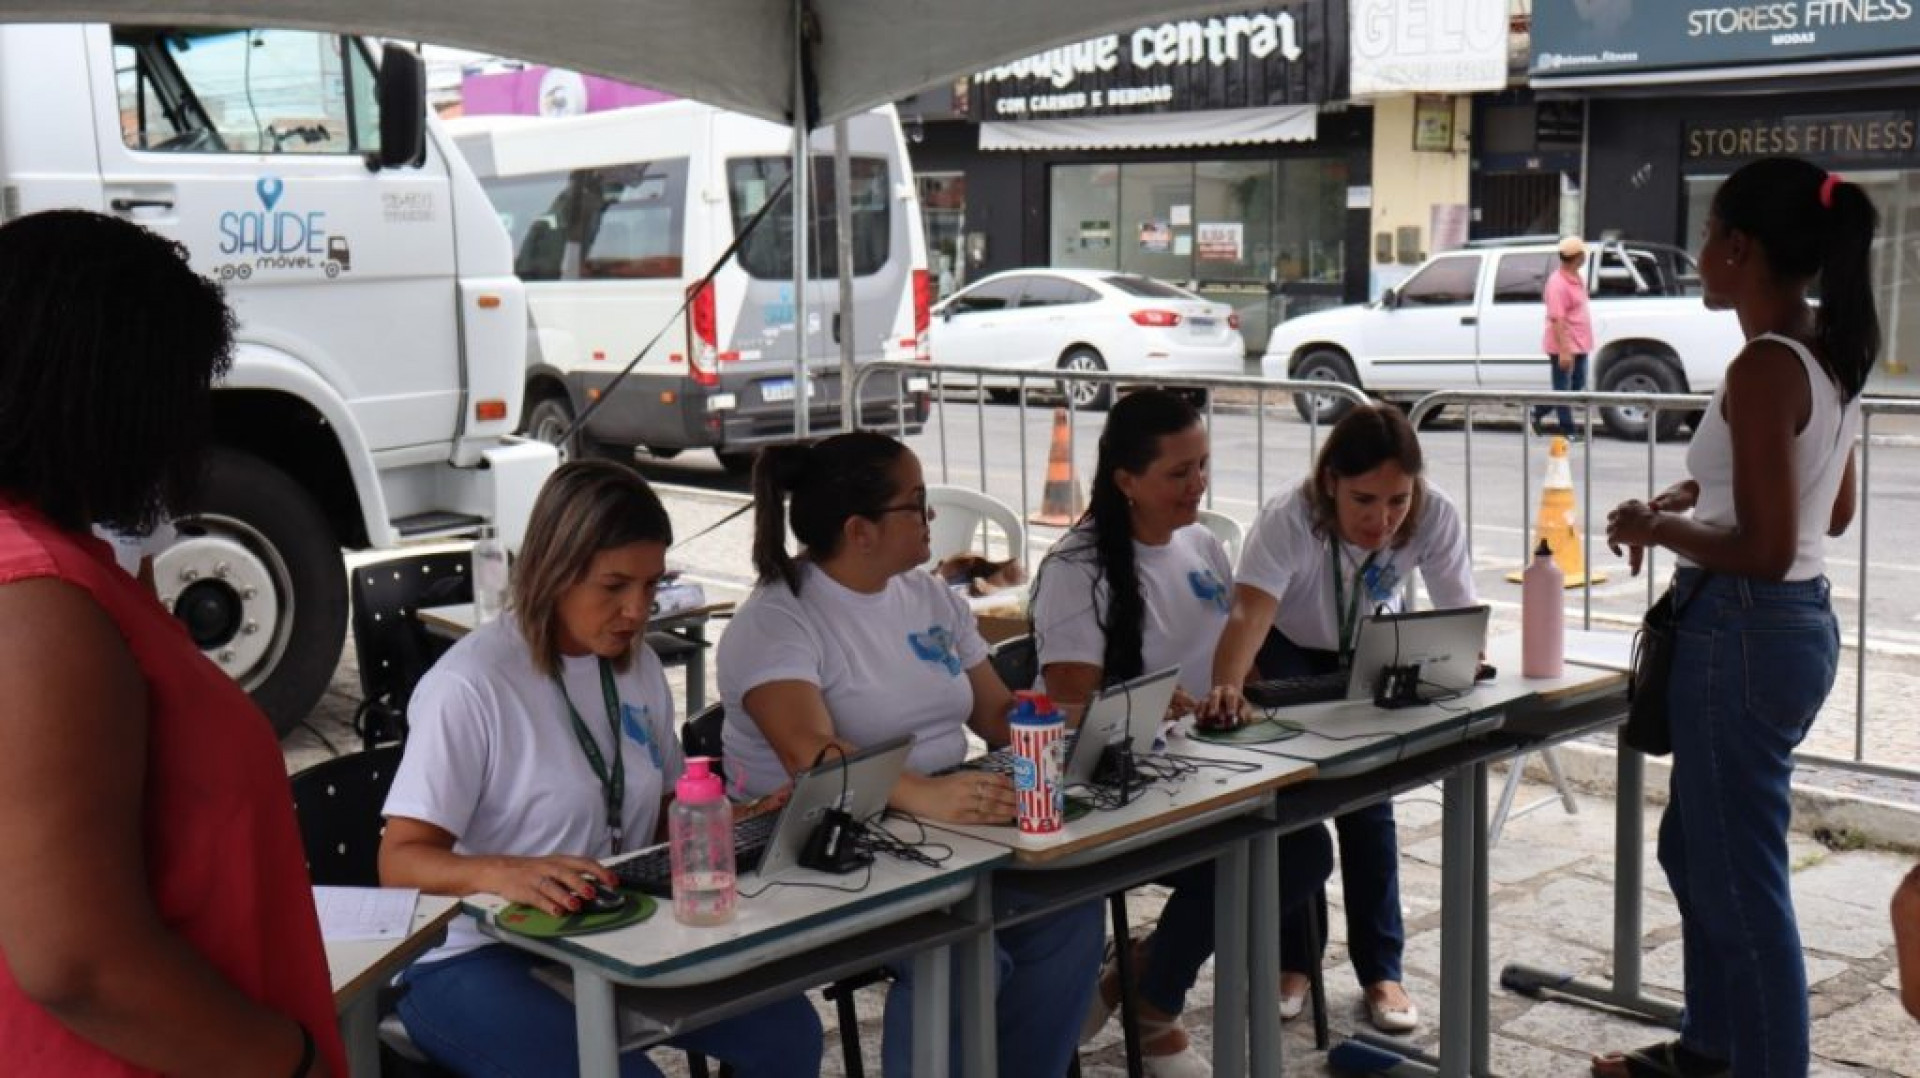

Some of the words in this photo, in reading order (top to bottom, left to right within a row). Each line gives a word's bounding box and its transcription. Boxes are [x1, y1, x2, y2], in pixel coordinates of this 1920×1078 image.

[1688, 3, 1798, 37] STORESS
[1805, 0, 1912, 27] FITNESS
[1131, 12, 1301, 69] central
[1772, 32, 1816, 45] MODAS
[996, 97, 1027, 114] COM
[1092, 89, 1103, 107] E
[1108, 83, 1172, 106] BEBIDAS
[1690, 127, 1800, 157] STORESS
[1805, 121, 1914, 151] FITNESS
